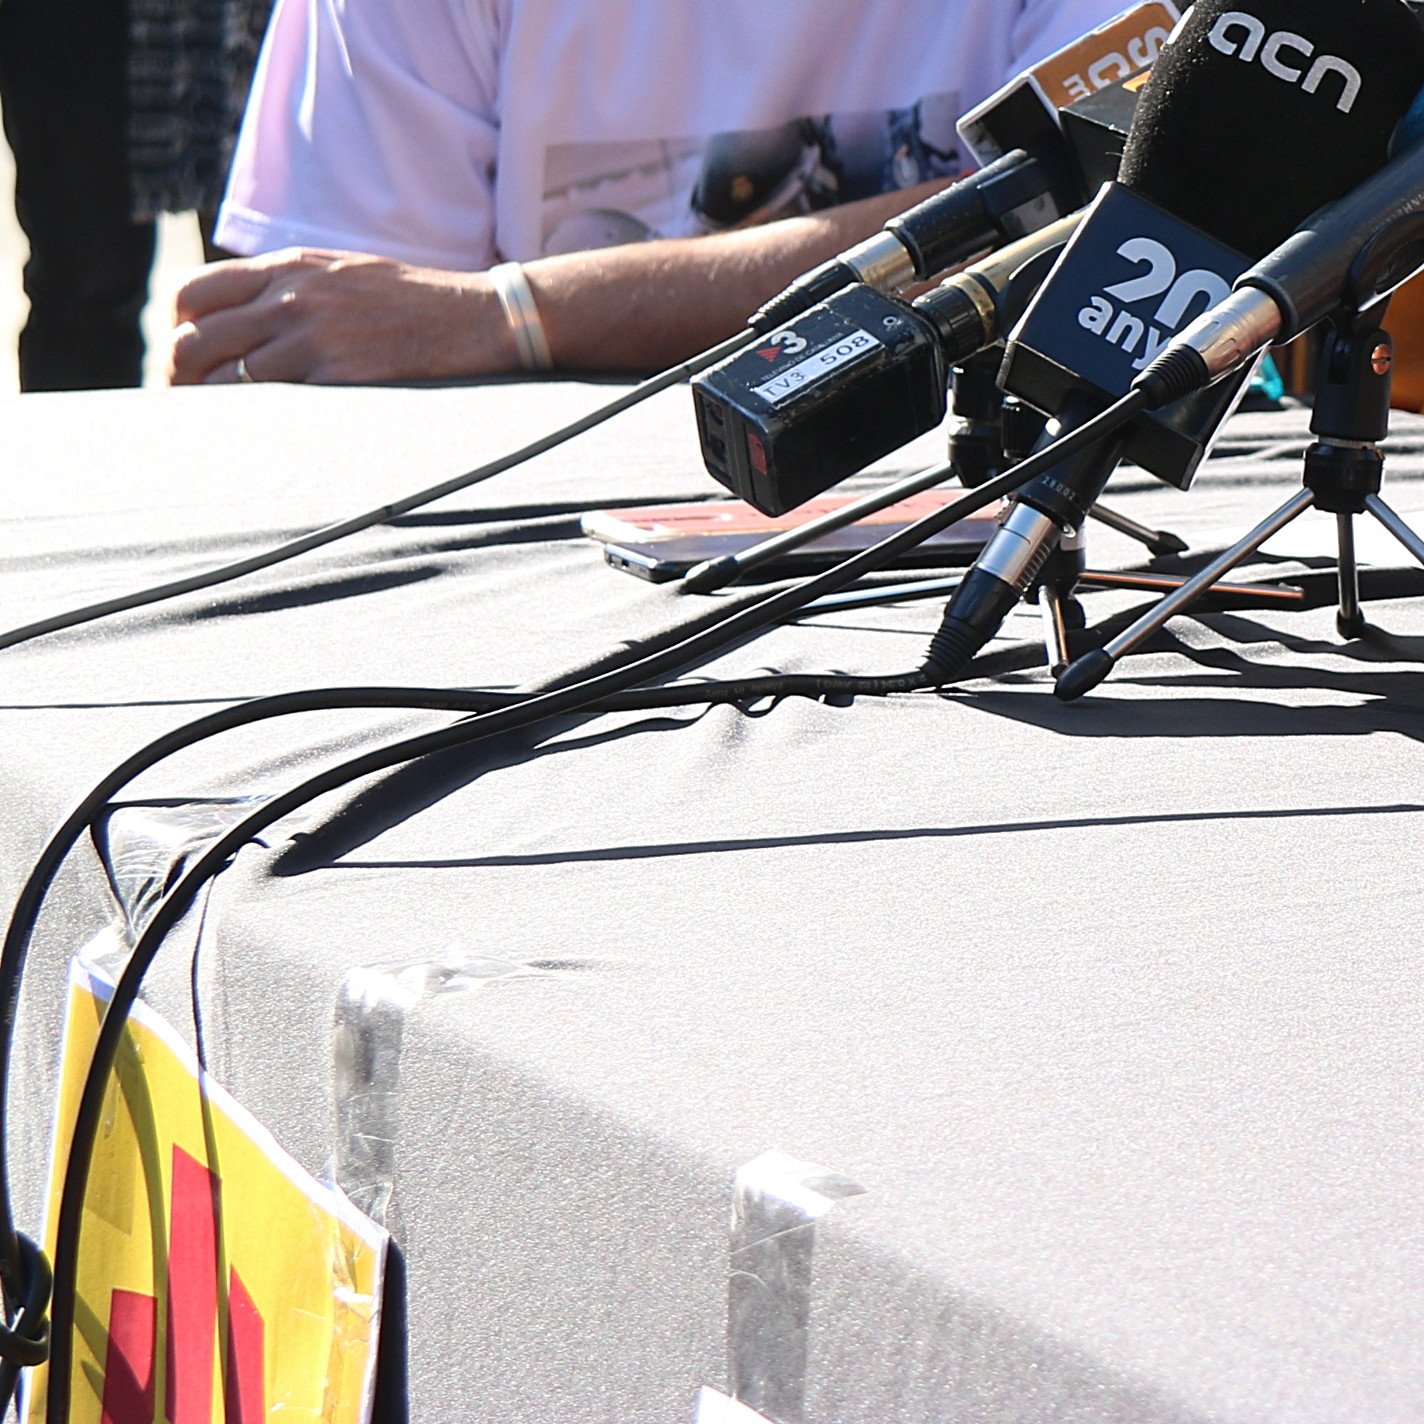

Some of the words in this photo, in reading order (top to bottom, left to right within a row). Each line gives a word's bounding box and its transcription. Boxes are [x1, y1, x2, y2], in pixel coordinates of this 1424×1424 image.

[1207, 11, 1362, 114] acn
[1103, 237, 1232, 329] 20
[763, 371, 805, 396] TV3
[820, 336, 869, 365] 508
[1078, 296, 1172, 370] any
